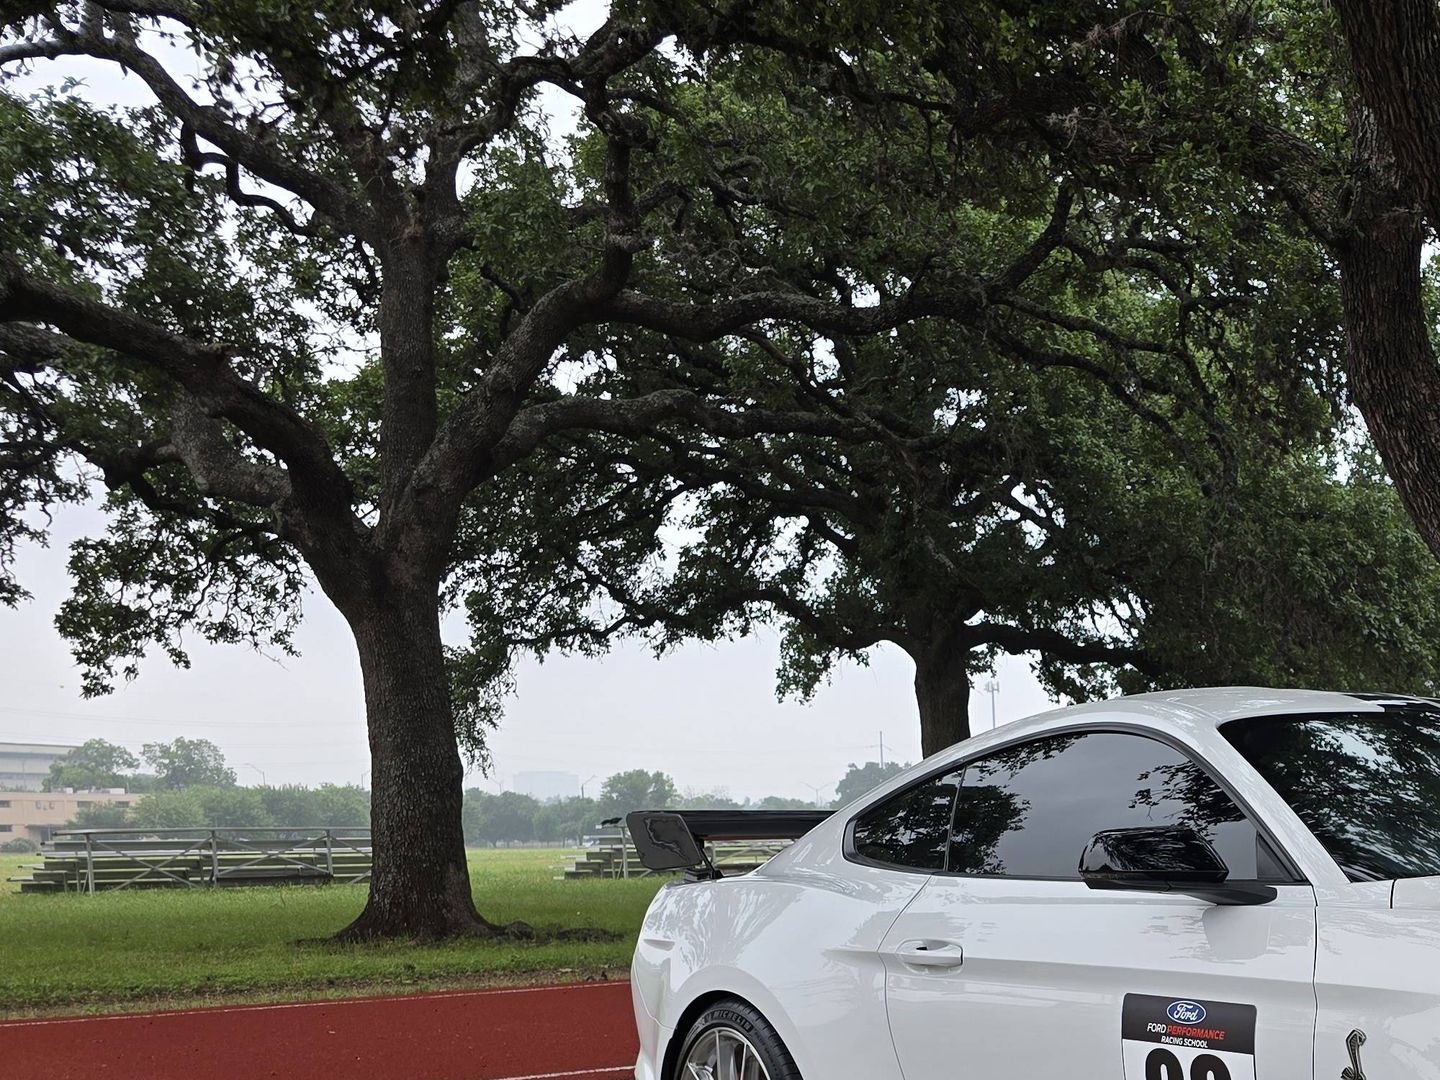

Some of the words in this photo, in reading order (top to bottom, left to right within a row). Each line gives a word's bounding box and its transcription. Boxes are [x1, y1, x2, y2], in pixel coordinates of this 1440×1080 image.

[714, 1011, 751, 1031] MICHELIN
[1173, 1004, 1198, 1021] Ford
[1147, 1022, 1167, 1034] FORD
[1167, 1025, 1225, 1040] PERFORMANCE
[1161, 1036, 1183, 1046] RACING
[1183, 1039, 1208, 1048] SCHOOL
